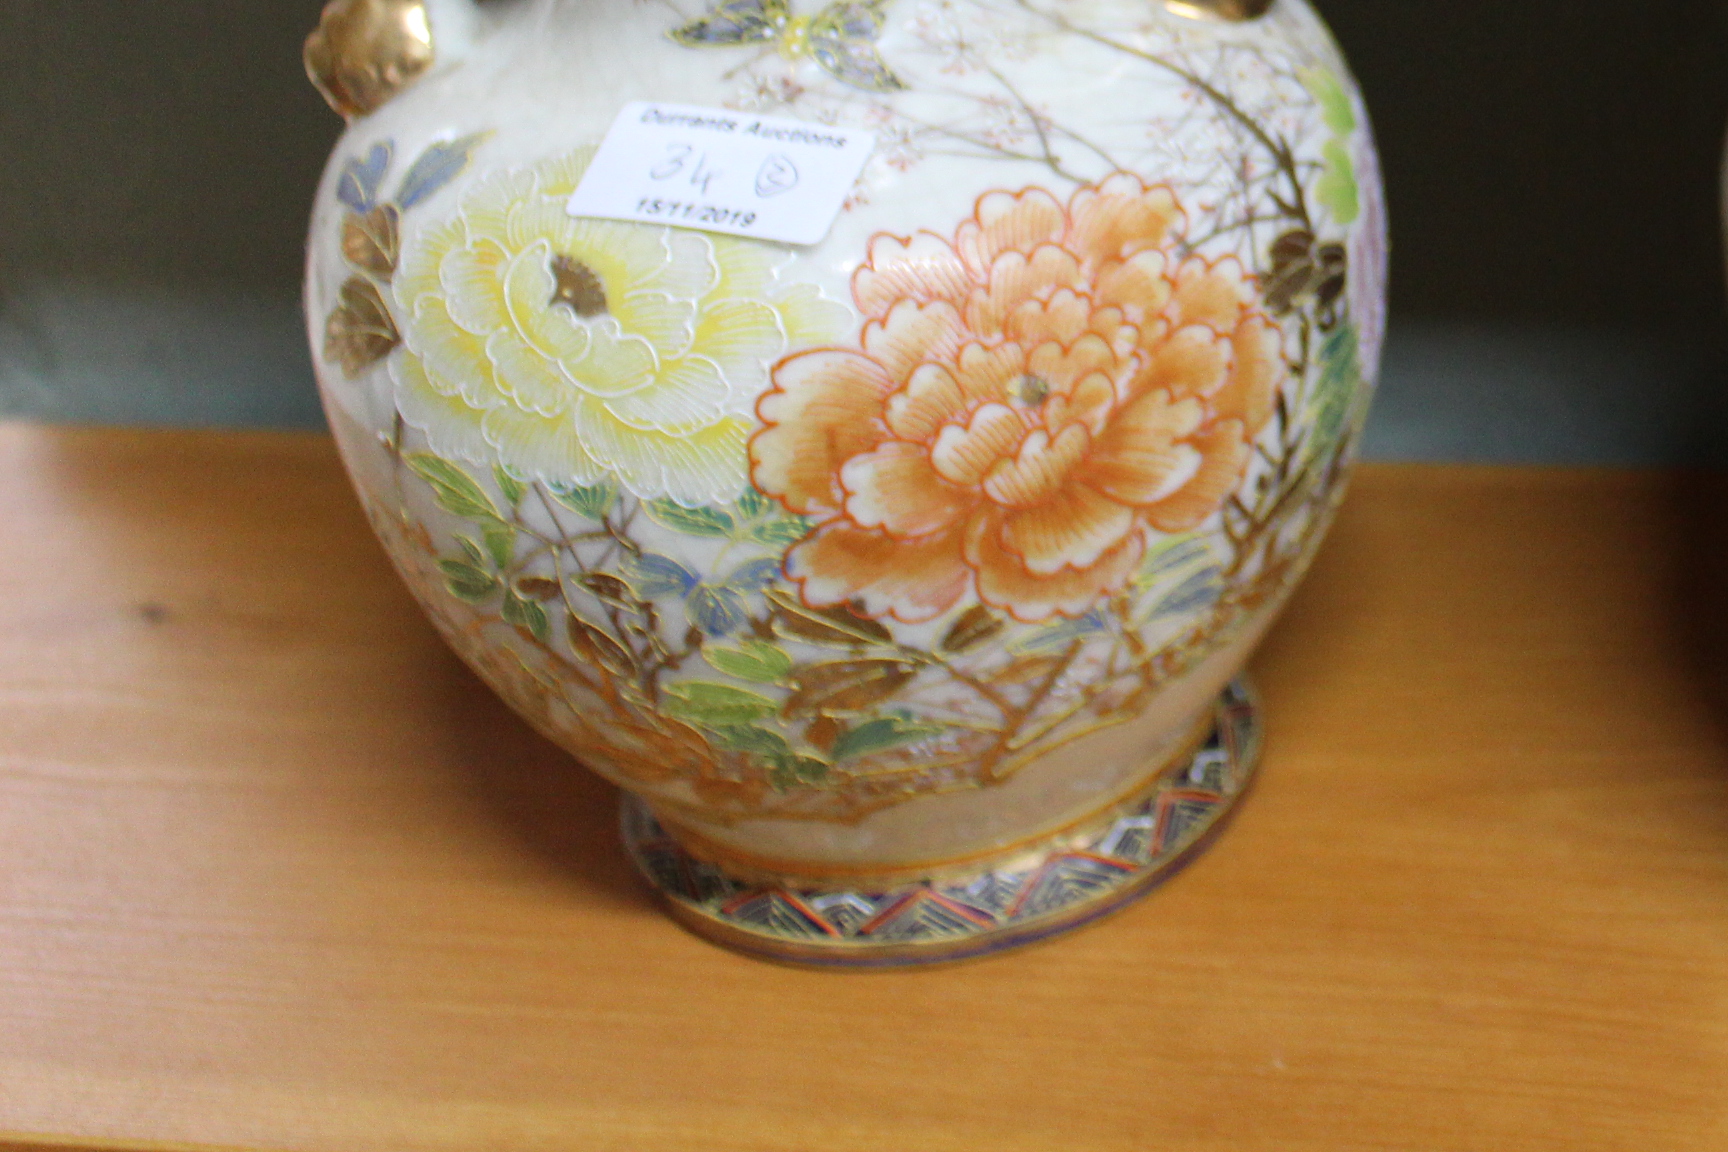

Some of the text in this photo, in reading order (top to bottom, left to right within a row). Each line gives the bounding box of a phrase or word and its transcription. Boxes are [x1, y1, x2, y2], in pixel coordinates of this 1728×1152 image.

[640, 108, 847, 148] Durrants Auctions
[635, 197, 758, 228] 15/11/2019
